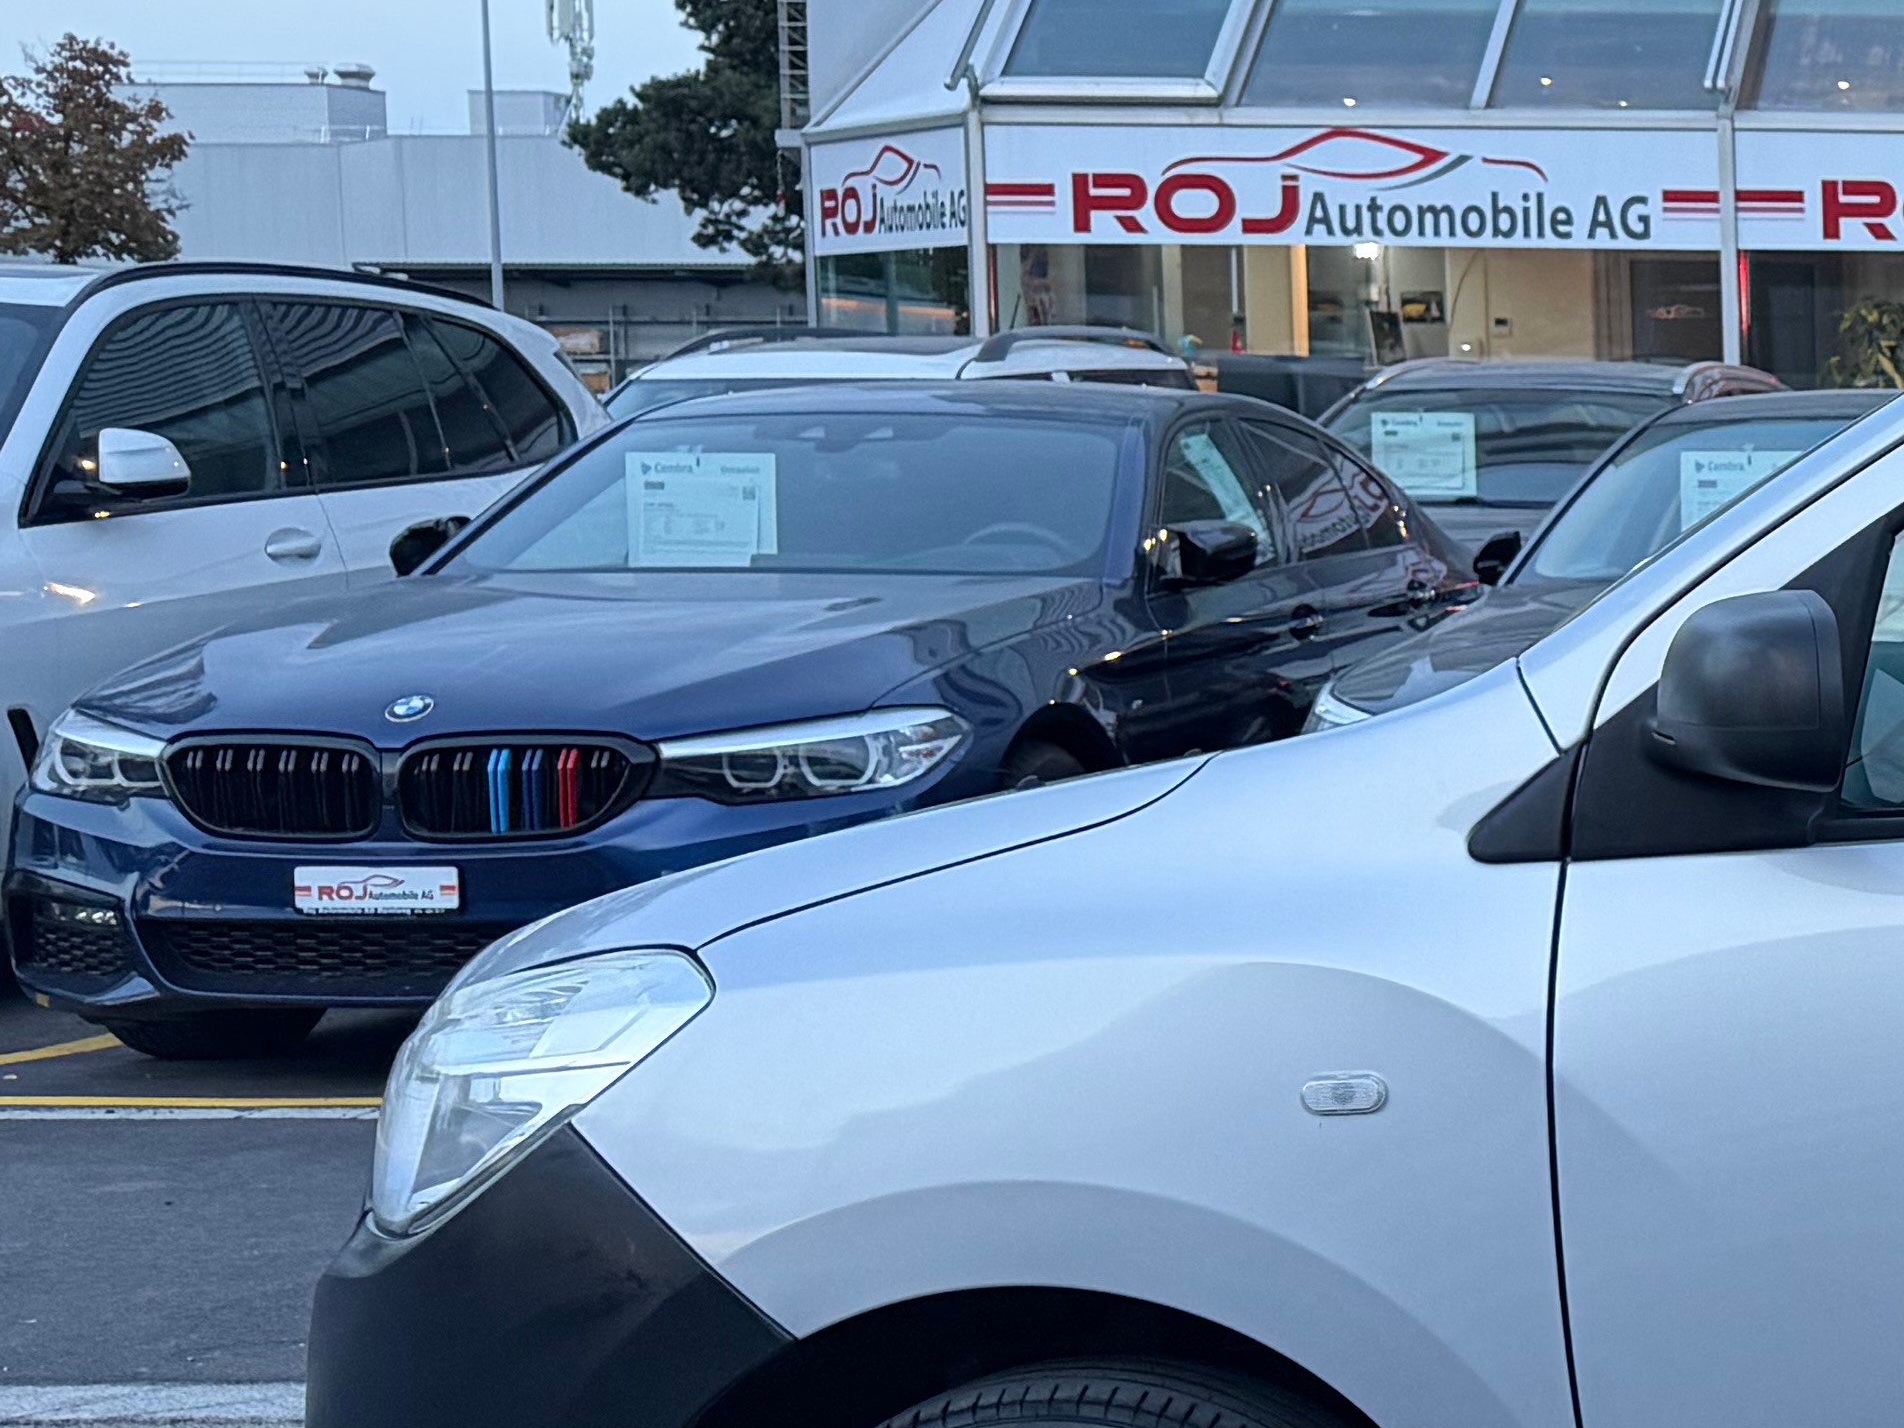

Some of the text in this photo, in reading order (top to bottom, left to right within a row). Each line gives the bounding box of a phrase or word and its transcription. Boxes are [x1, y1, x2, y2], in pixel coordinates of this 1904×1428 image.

[820, 183, 966, 238] ROJ Automobile AG
[1071, 172, 1652, 241] ROJ Automobile AG
[317, 881, 435, 901] ROJ Automobile AG
